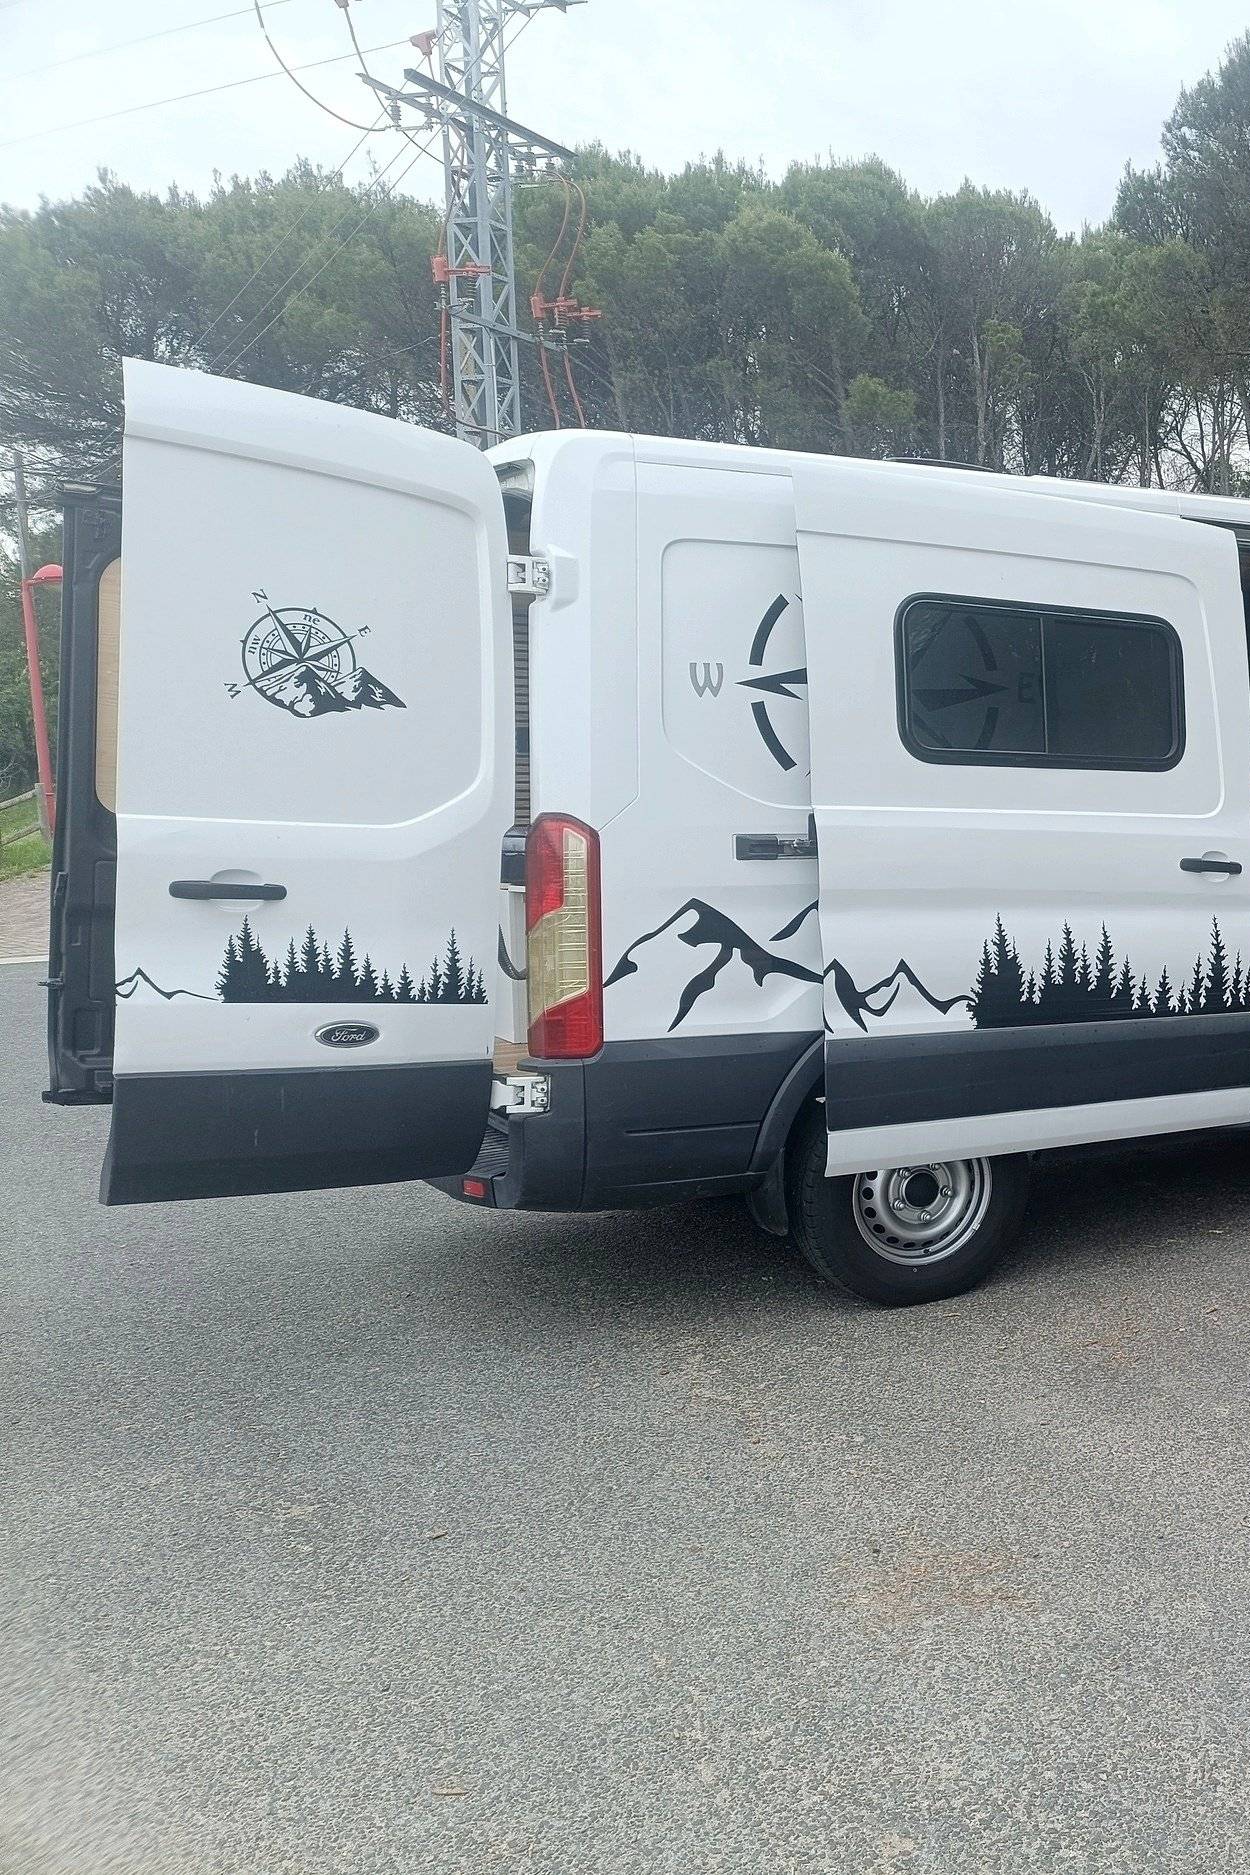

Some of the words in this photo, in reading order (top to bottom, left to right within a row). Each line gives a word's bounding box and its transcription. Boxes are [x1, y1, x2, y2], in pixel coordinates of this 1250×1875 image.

[251, 588, 268, 603] N
[302, 613, 321, 626] ne
[357, 624, 372, 638] E
[248, 634, 261, 655] nw
[689, 662, 724, 698] W
[331, 1028, 367, 1042] Ford
